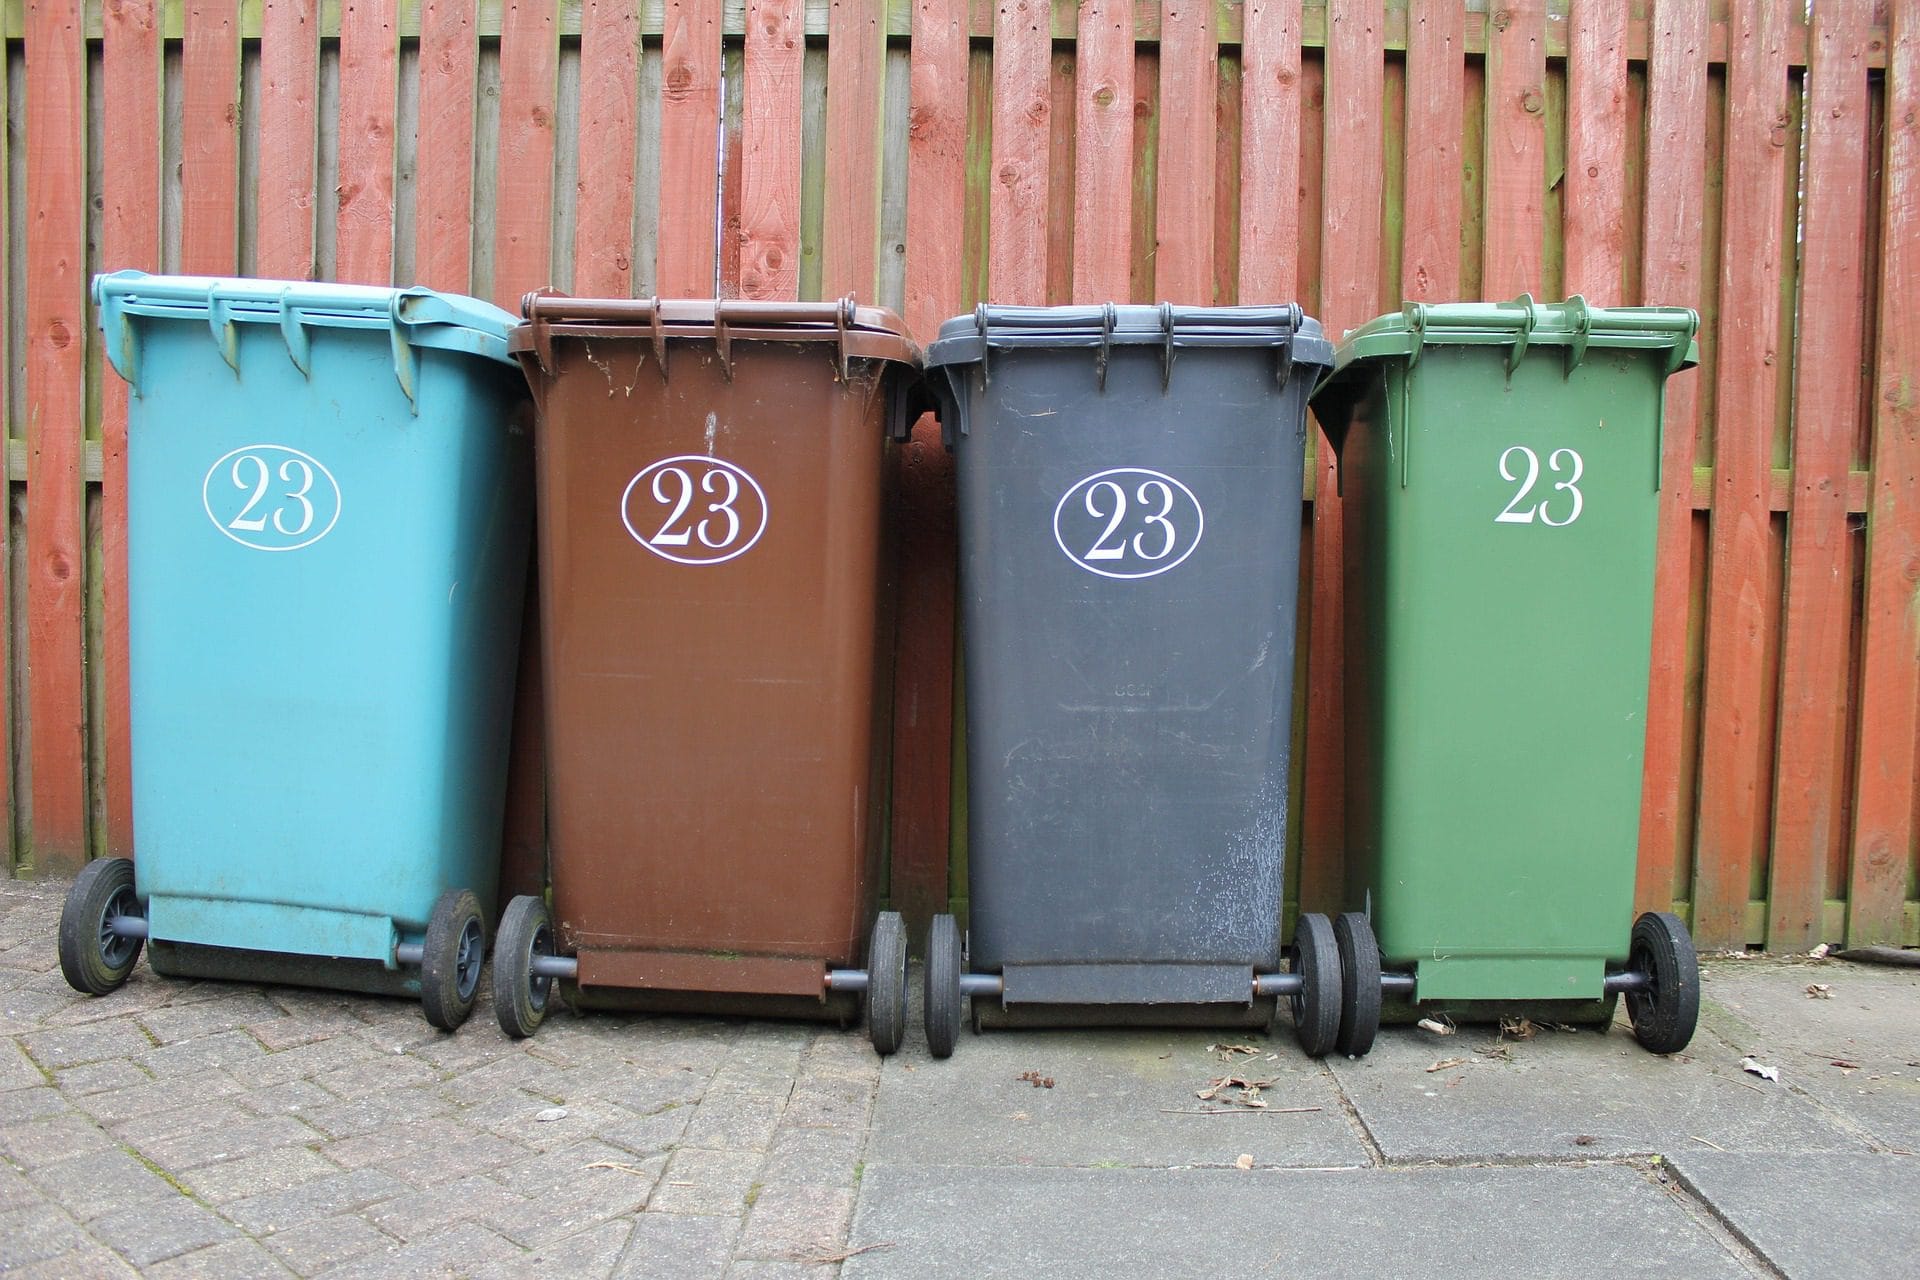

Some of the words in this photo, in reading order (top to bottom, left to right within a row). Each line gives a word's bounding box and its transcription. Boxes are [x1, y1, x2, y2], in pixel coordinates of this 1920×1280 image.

[228, 455, 314, 535] 23
[649, 467, 740, 548] 23
[1083, 480, 1176, 560] 23
[1494, 446, 1584, 527] 23
